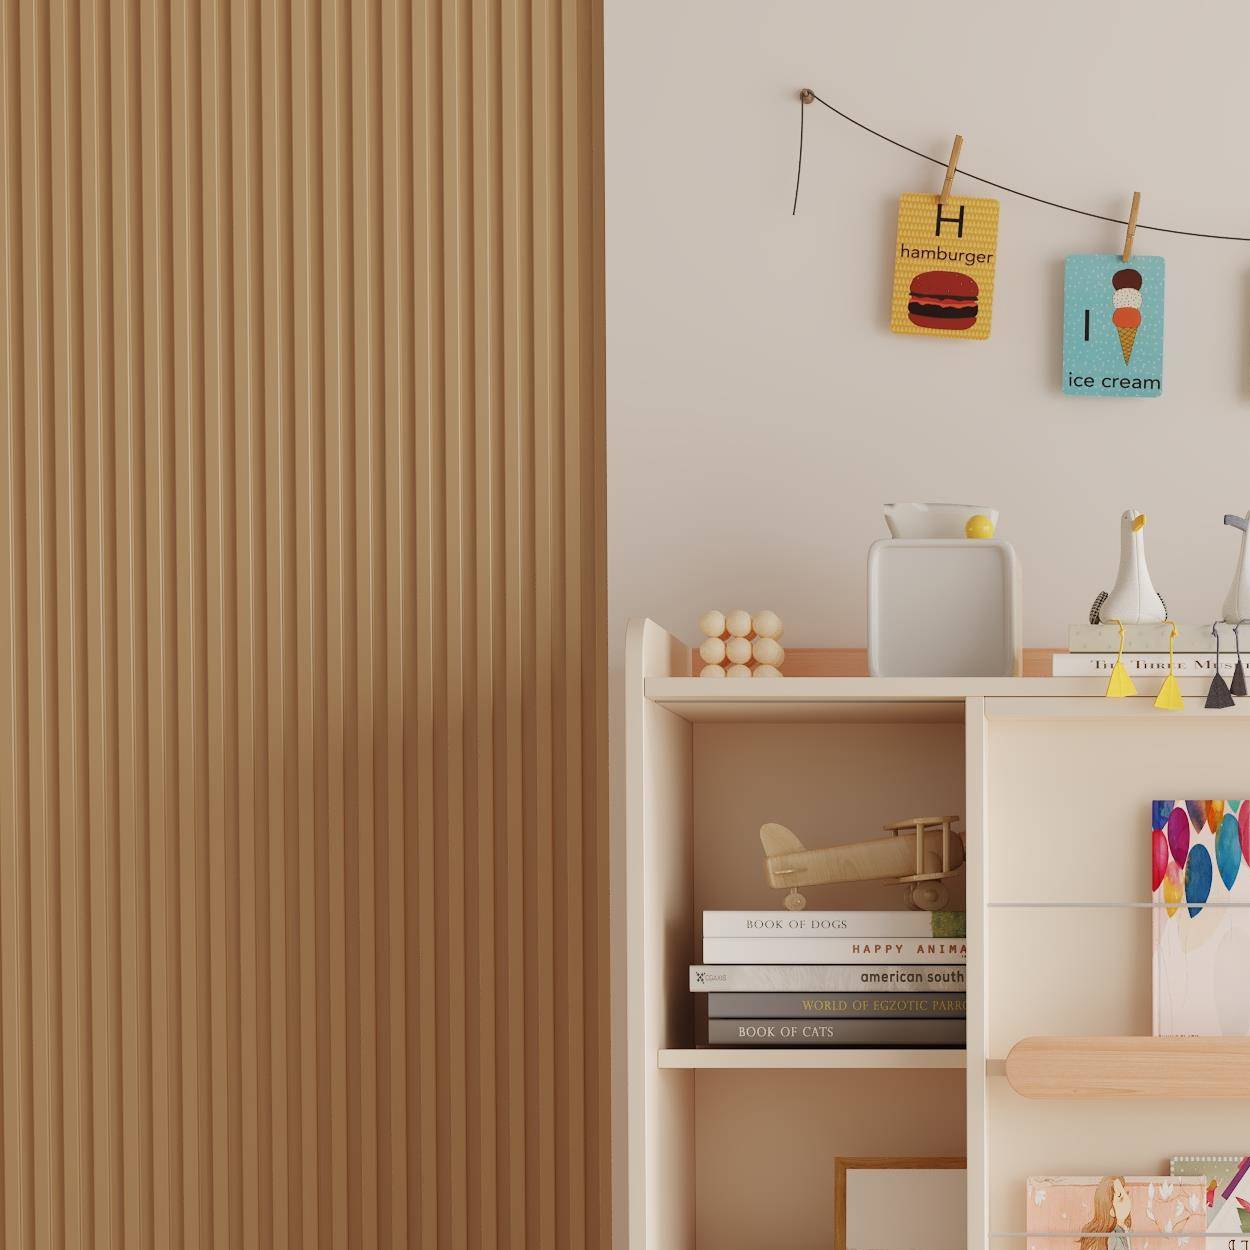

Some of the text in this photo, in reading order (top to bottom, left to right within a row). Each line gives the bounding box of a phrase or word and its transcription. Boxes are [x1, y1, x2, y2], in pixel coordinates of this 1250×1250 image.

[935, 204, 964, 238] H
[900, 243, 994, 266] hamburger
[1069, 372, 1162, 390] ice cream
[746, 920, 848, 929] BOOK OF DOGS
[852, 944, 904, 954] HAPPY
[860, 970, 923, 983] american
[928, 970, 964, 983] south
[802, 1000, 848, 1011] WORLD
[852, 1000, 869, 1011] OF
[873, 1000, 928, 1011] EGZOTIC
[738, 1026, 834, 1038] BOOK OF CATS
